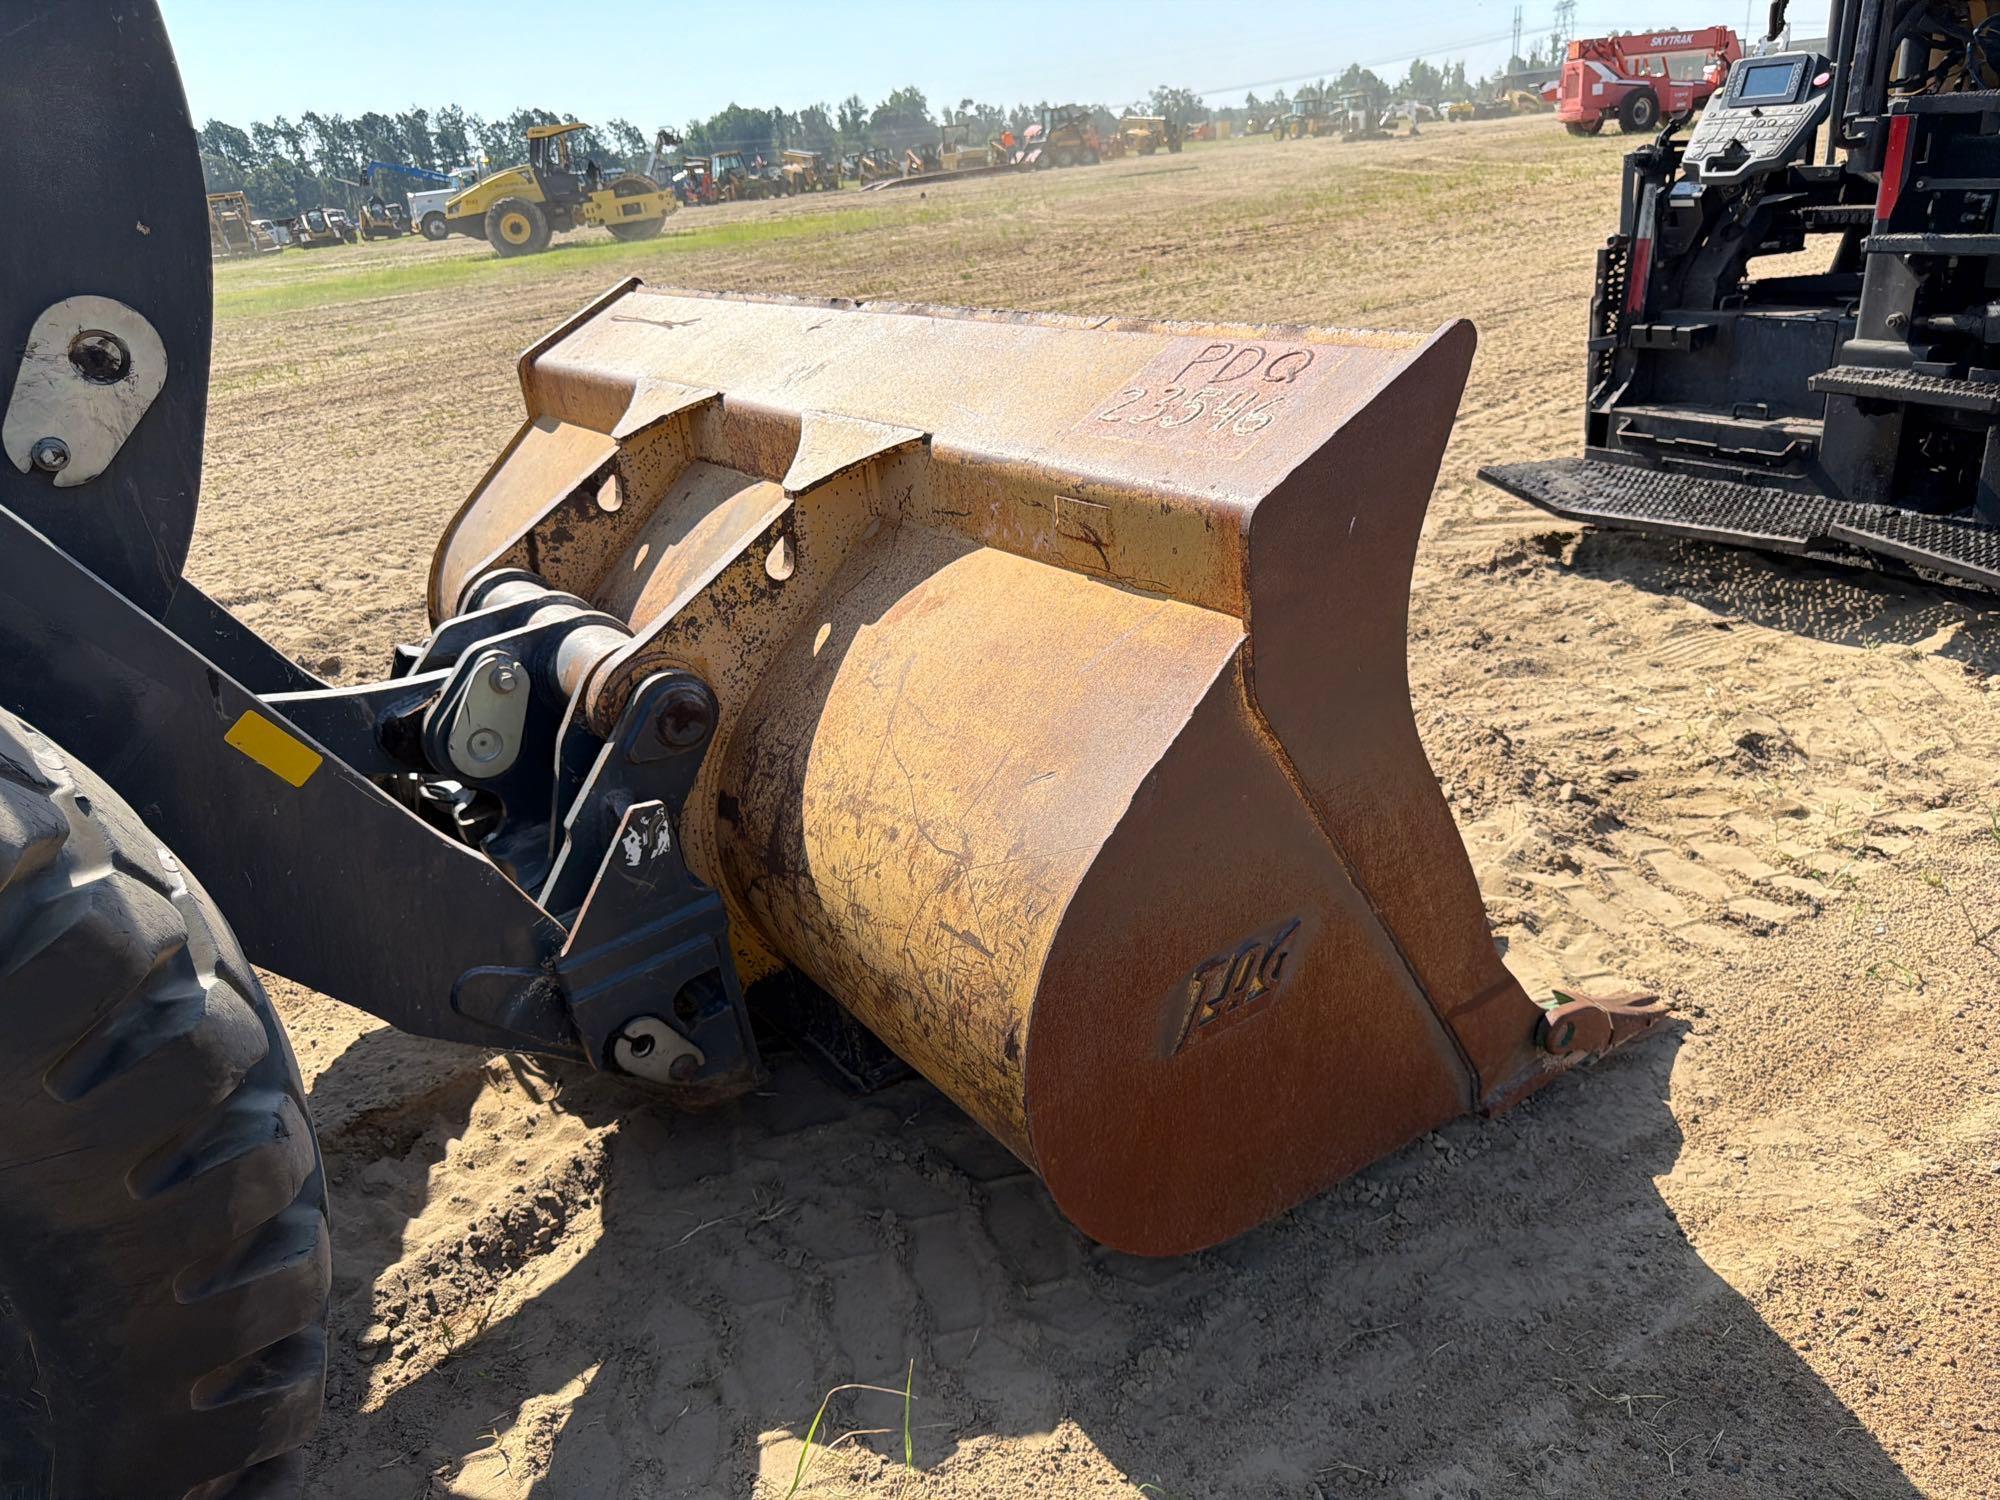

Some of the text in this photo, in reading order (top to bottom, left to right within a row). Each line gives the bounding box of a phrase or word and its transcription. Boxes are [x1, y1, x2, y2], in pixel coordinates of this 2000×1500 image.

[1650, 33, 1694, 47] SKYTRAK
[1170, 342, 1314, 384] PDQ
[1096, 385, 1287, 436] 23546
